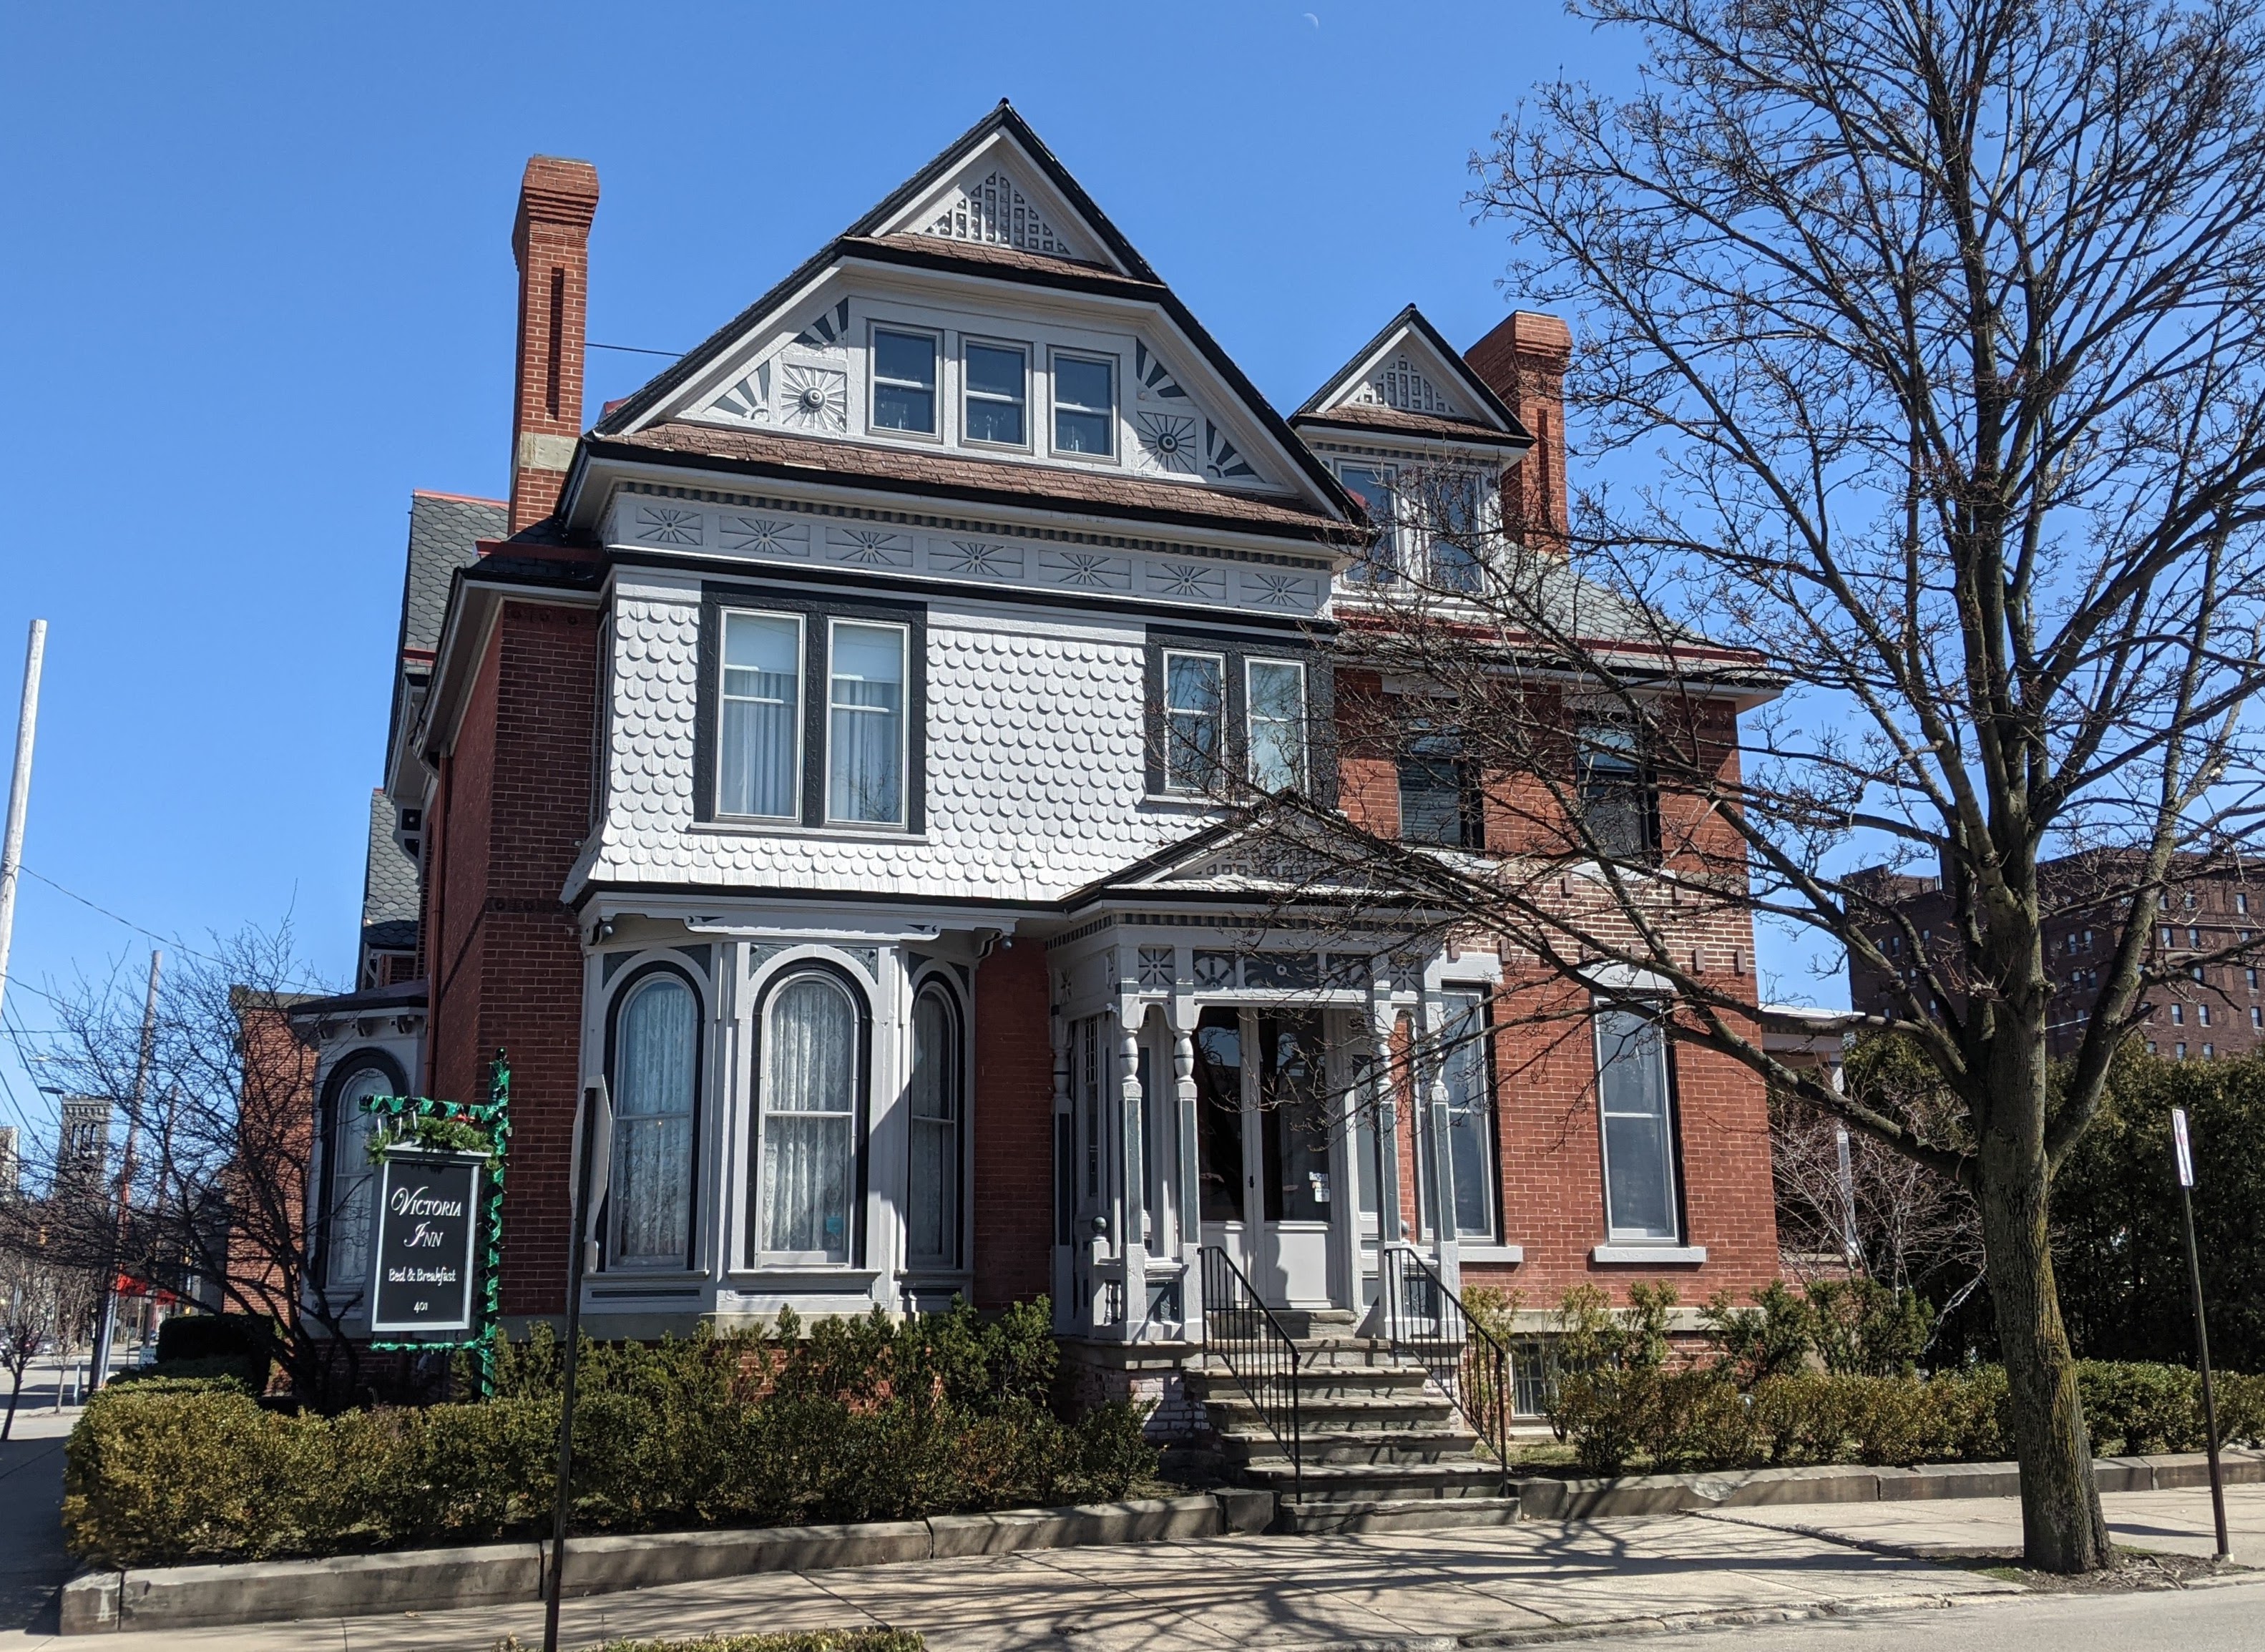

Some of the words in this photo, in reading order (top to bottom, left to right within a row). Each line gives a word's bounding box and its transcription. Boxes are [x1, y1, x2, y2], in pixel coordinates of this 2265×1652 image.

[391, 1186, 461, 1216] VICTORIA
[403, 1221, 444, 1248] INN
[388, 1266, 406, 1282] Bed
[406, 1268, 416, 1282] &
[416, 1266, 456, 1286] Breakfast
[414, 1301, 429, 1314] 401
